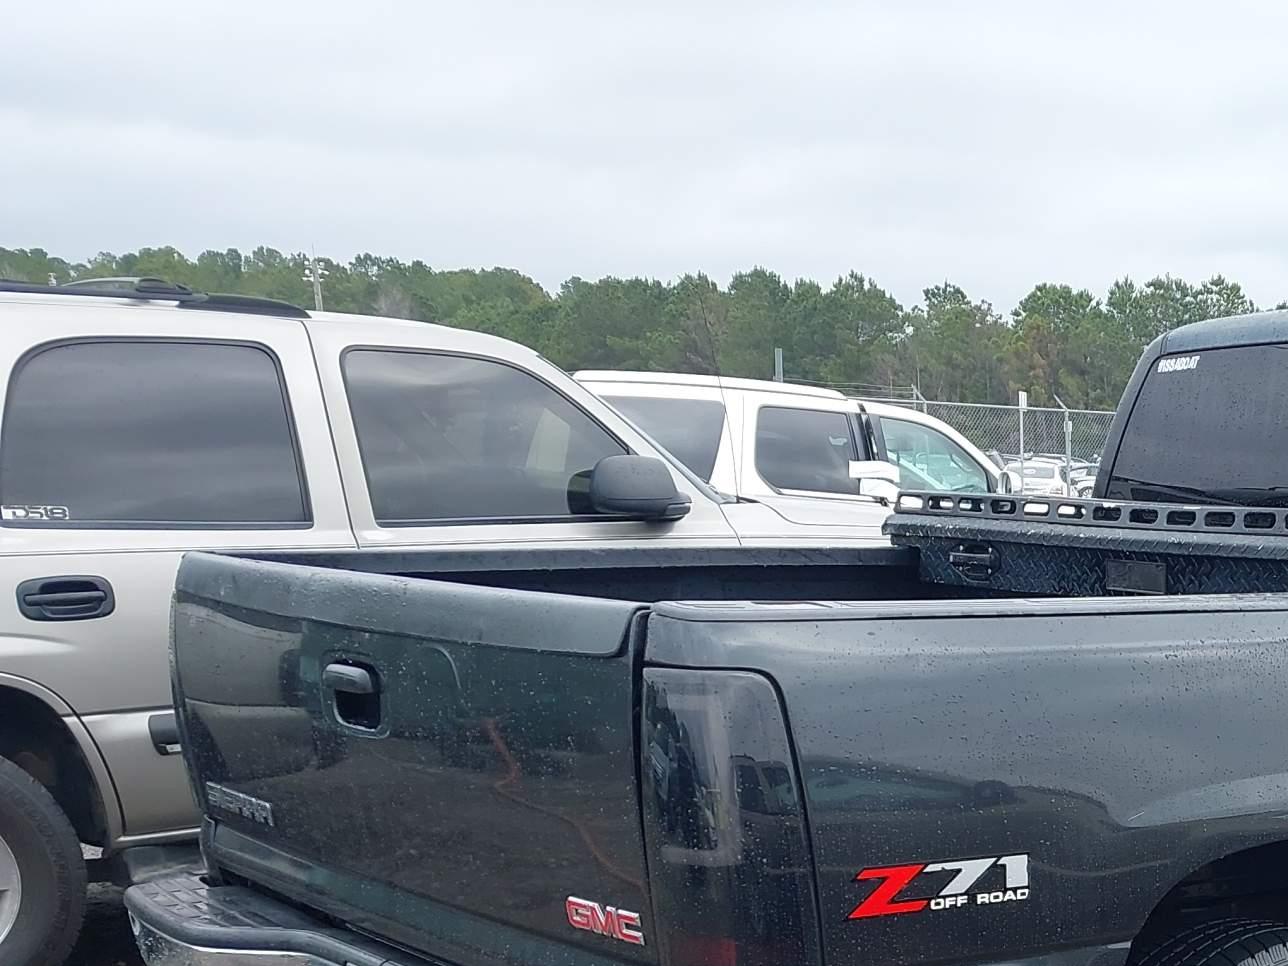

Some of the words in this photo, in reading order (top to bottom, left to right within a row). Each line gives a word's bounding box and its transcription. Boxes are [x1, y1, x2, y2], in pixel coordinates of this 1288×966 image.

[846, 853, 1030, 920] Z71
[930, 895, 969, 911] OFF
[976, 888, 1030, 906] ROAD
[564, 895, 646, 946] GMC
